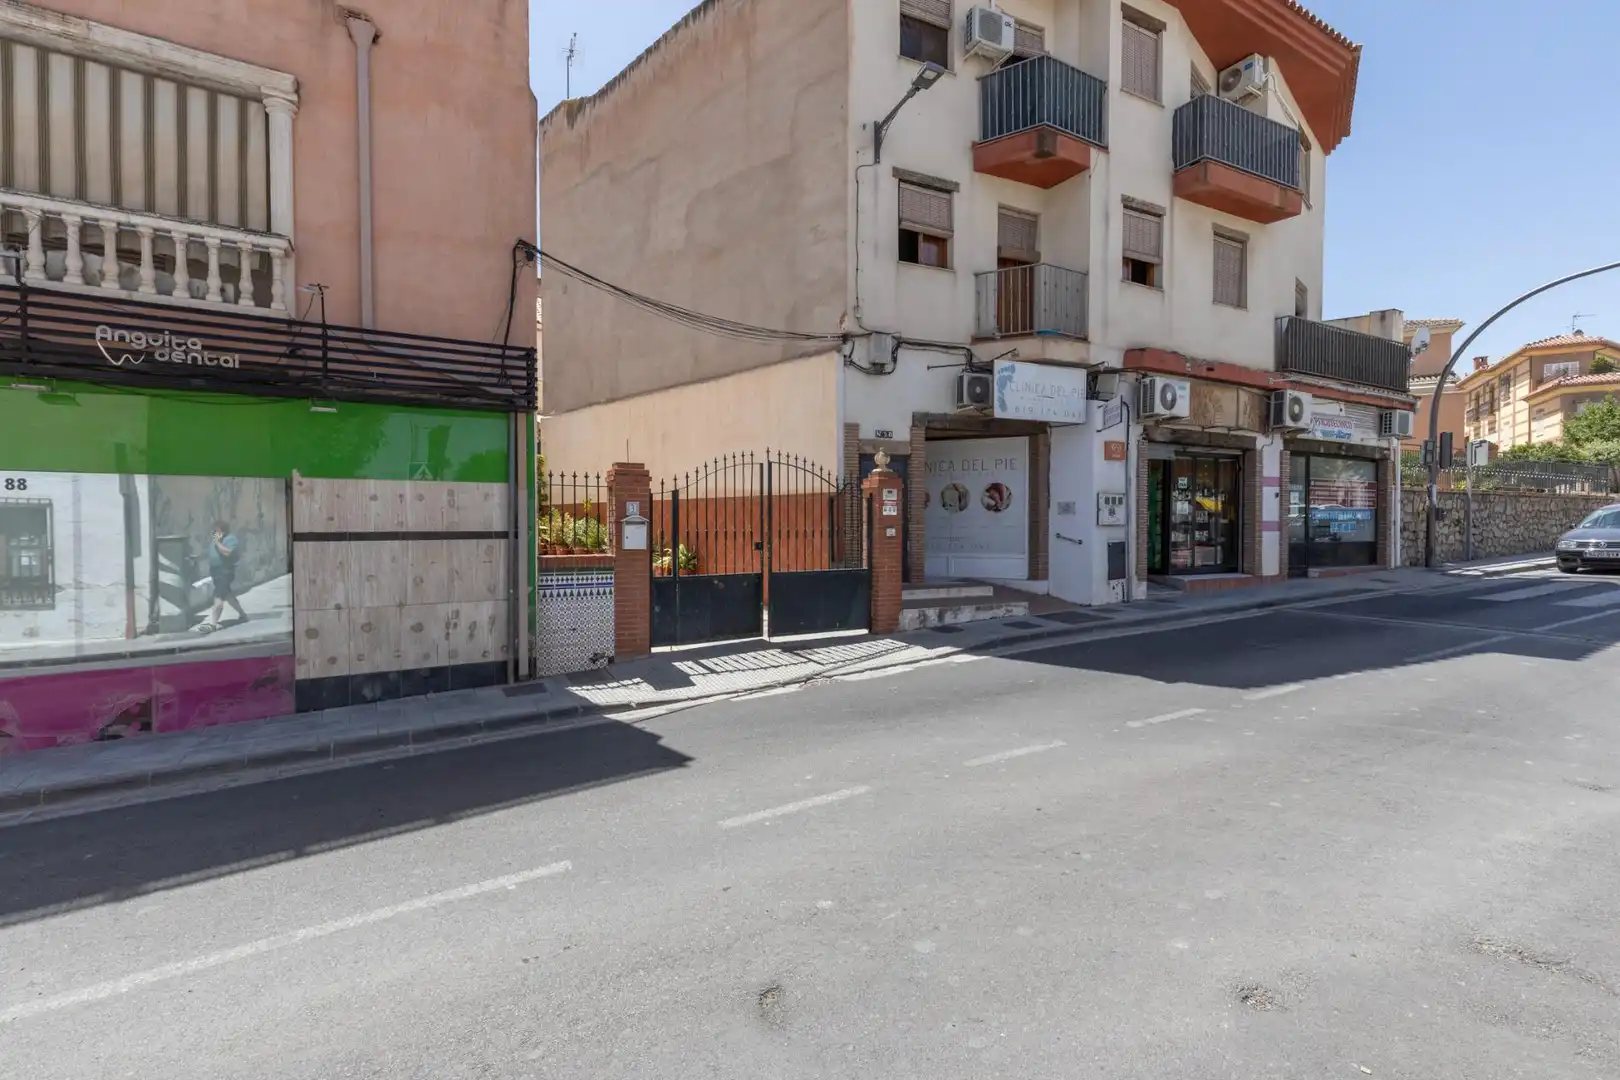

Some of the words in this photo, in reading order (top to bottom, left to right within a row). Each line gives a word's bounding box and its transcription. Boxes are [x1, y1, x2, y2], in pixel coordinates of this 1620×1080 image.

[95, 325, 202, 351] Anguita
[154, 348, 240, 369] dental
[1050, 384, 1068, 398] DEL
[1071, 387, 1085, 400] PIE
[961, 458, 990, 472] DEL
[994, 457, 1018, 471] PIE
[4, 478, 28, 491] 88
